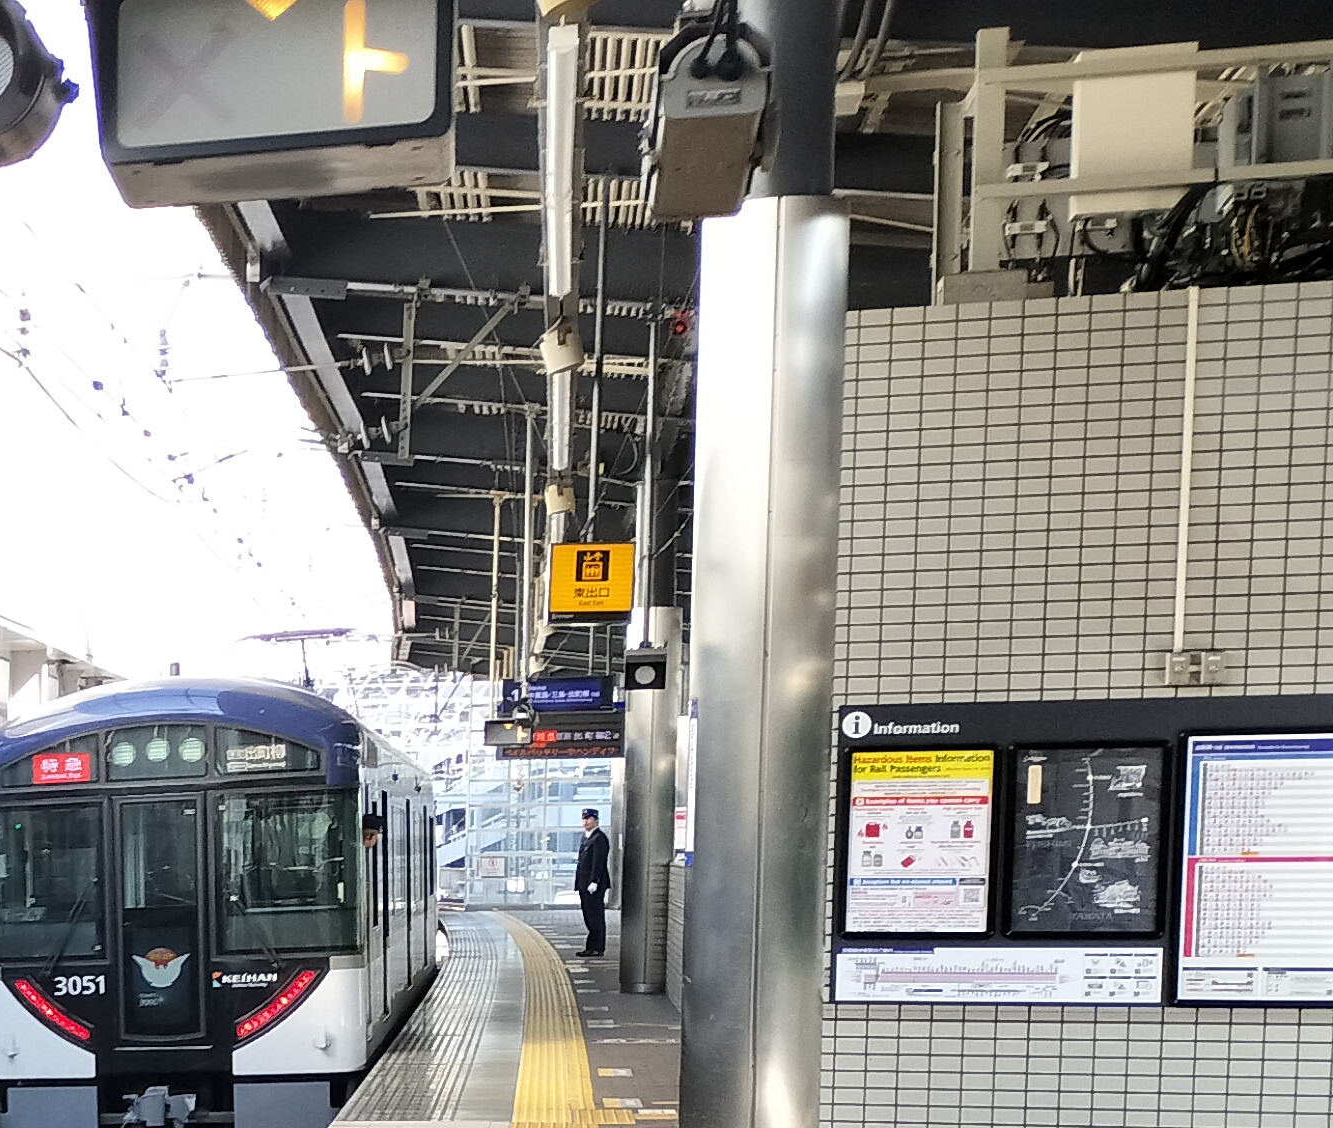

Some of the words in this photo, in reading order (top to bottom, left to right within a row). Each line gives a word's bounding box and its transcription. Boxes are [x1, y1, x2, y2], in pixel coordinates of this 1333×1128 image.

[873, 721, 960, 735] Information
[935, 753, 991, 764] Information
[221, 972, 278, 984] KEIHAN
[53, 974, 106, 996] 3051
